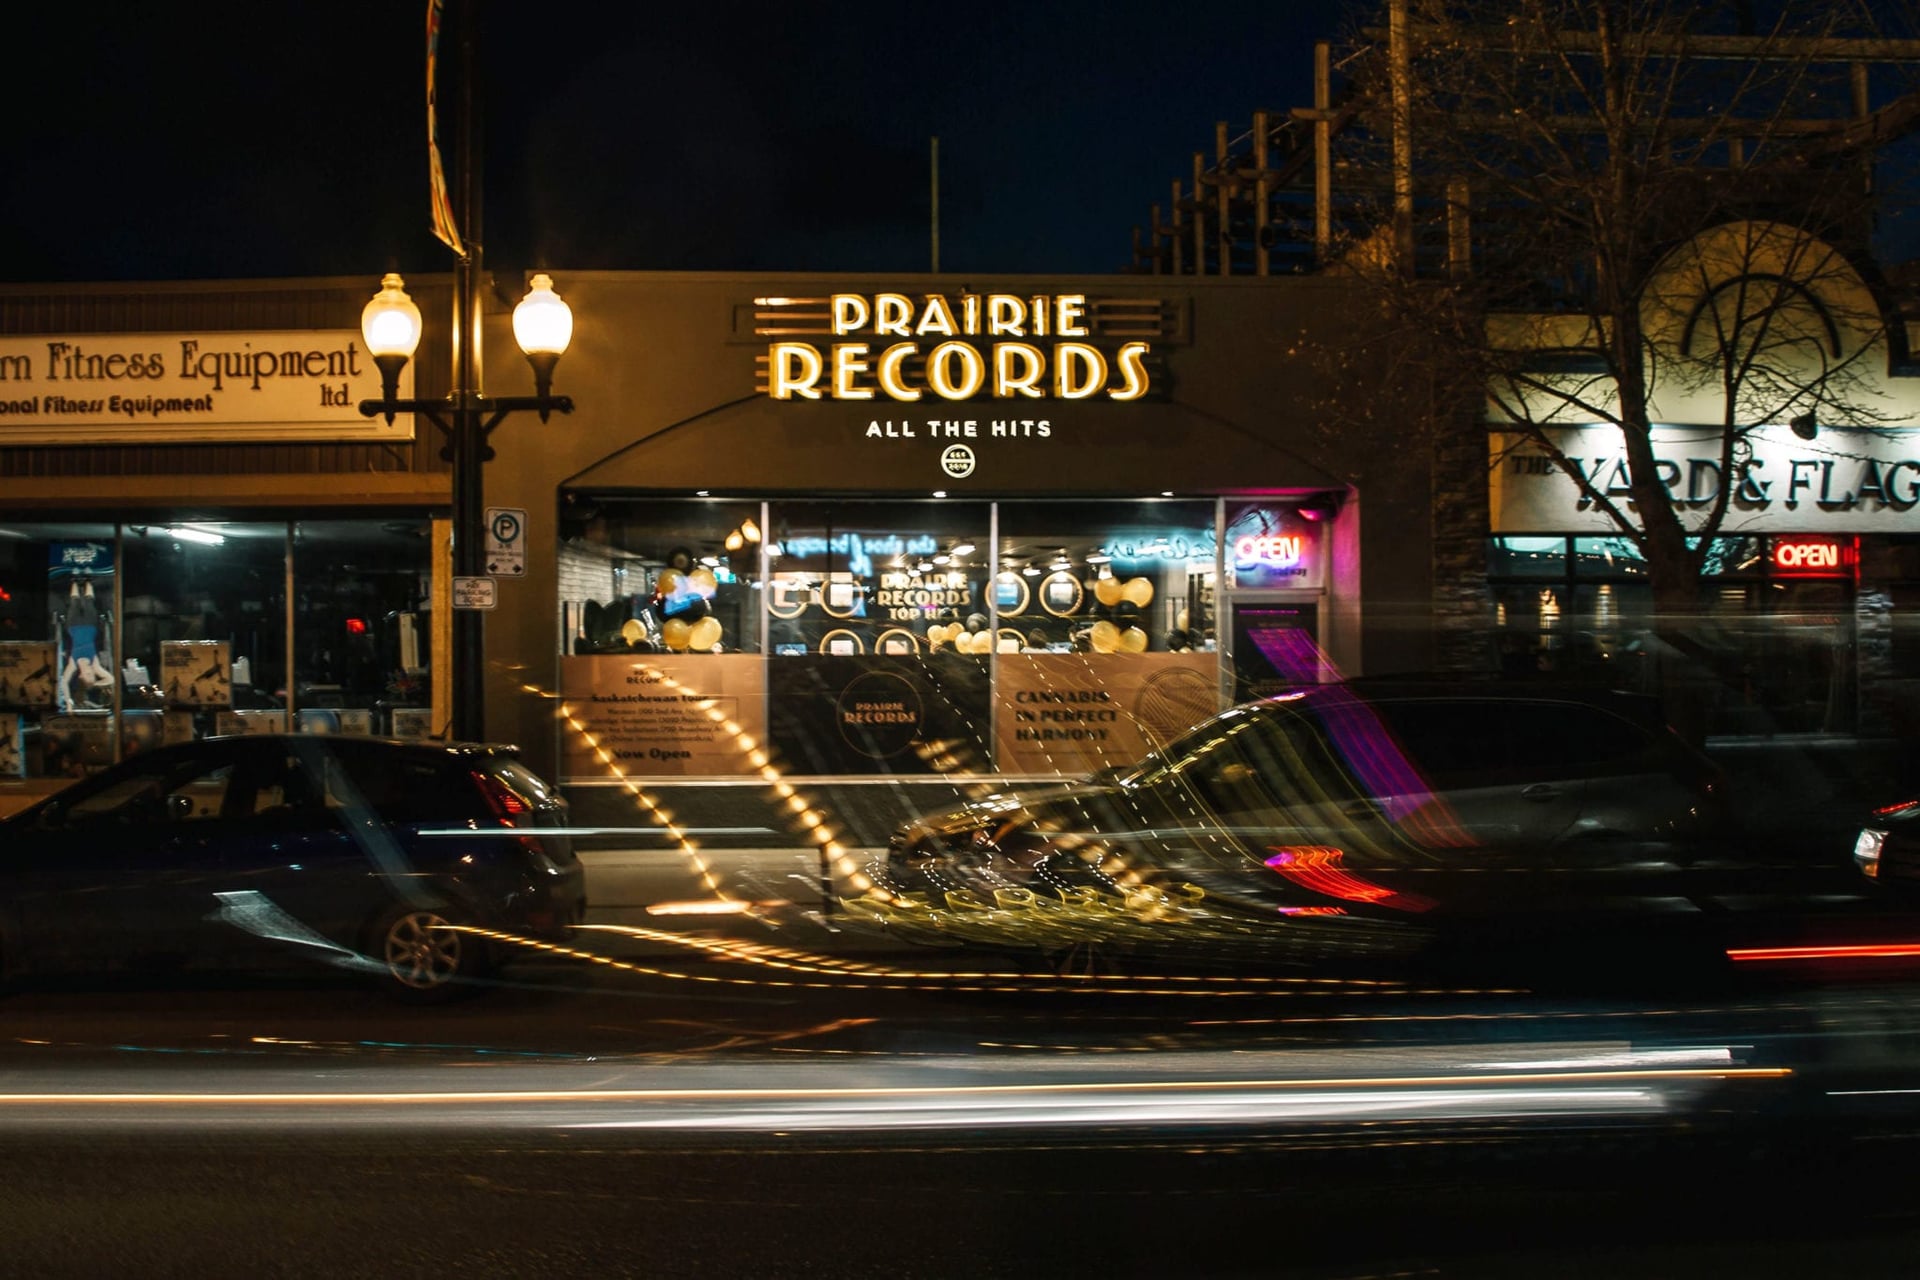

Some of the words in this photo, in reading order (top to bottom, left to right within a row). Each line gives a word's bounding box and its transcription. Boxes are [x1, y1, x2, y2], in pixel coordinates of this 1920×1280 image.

[831, 293, 1088, 337] PRAIRIE
[46, 342, 165, 380] Fitness
[179, 340, 362, 390] Equipment
[769, 341, 1150, 400] RECORDS
[43, 396, 105, 413] Fitness
[108, 395, 214, 416] Equipment
[865, 420, 916, 438] ALL
[927, 420, 978, 438] THE
[991, 420, 1051, 438] HITS
[1511, 455, 1553, 475] THE
[1739, 459, 1772, 503] &
[1236, 536, 1300, 561] OPEN
[1777, 544, 1838, 566] OPEN
[877, 590, 970, 606] RECORDS
[888, 607, 920, 620] TOP
[1016, 691, 1110, 704] CANNABIS
[844, 711, 916, 724] RECORDS
[1016, 710, 1035, 722] IN
[1040, 710, 1117, 722] PERFECT
[1016, 729, 1108, 741] HARMONY
[650, 747, 691, 763] Open
